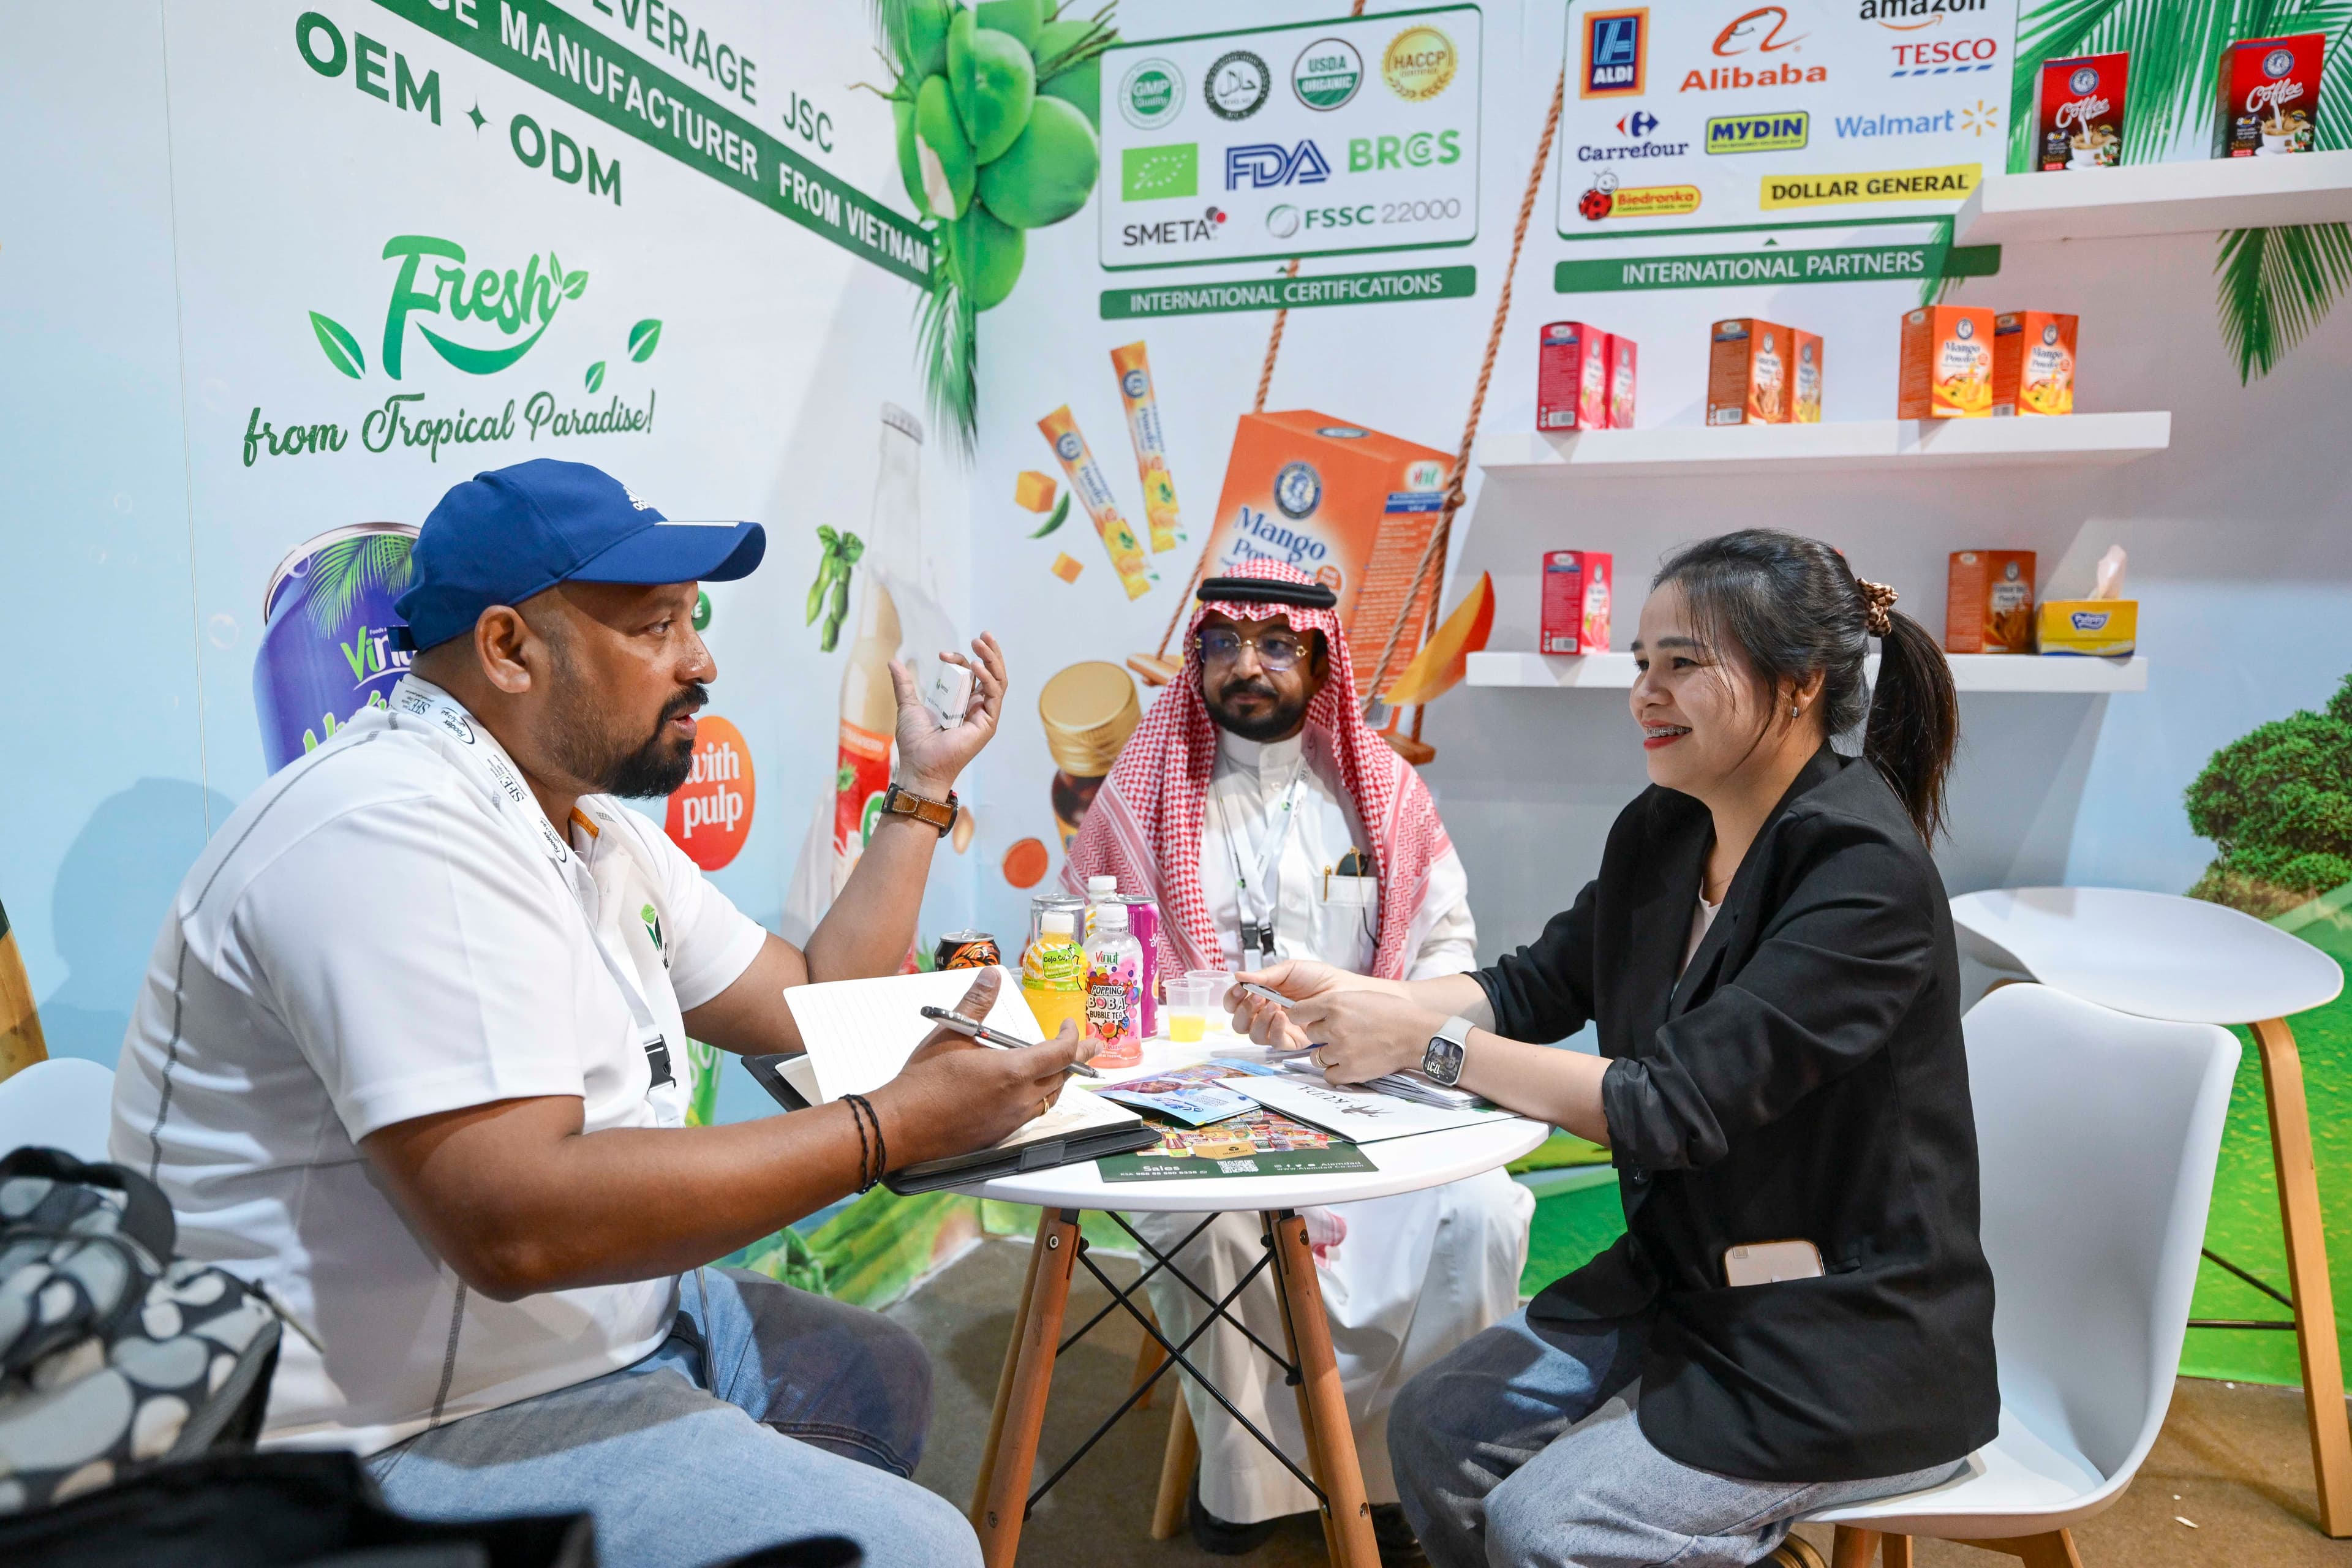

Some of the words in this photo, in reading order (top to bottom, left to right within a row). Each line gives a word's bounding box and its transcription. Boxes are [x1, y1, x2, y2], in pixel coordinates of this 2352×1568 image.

[1309, 56, 1346, 72] USDA
[1393, 51, 1446, 69] HACCP
[1892, 38, 1997, 66] TESCO
[296, 11, 442, 126] OEM
[1593, 66, 1634, 85] ALDI
[1679, 64, 1828, 92] Alibaba
[1134, 80, 1170, 97] GMP
[1302, 76, 1353, 93] ORGANIC
[2245, 78, 2304, 113] Coffee
[783, 91, 834, 153] JSC
[1836, 110, 1954, 139] Walmart
[2056, 94, 2111, 128] Coffee
[500, 0, 759, 181] MANUFACTURER
[779, 162, 840, 227] FROM
[846, 201, 929, 274] VIETNAM
[1712, 118, 1803, 141] MYDIN
[510, 113, 621, 206] ODM
[1226, 140, 1332, 190] FDA
[1578, 141, 1689, 162] Carrefour
[1617, 192, 1694, 206] Biedronka
[1771, 181, 1857, 201] DOLLAR
[1866, 173, 1969, 195] GENERAL
[1305, 205, 1376, 230] FSSC
[1381, 197, 1461, 225] 22000
[1123, 217, 1212, 247] SMETA
[1622, 257, 1800, 284] INTERNATIONAL
[1806, 251, 1924, 276] PARTNERS
[1130, 284, 1280, 312] INTERNATIONAL
[1283, 273, 1442, 300] CERTIFICATIONS
[382, 235, 562, 381] Fresh
[243, 407, 348, 467] from
[362, 393, 515, 463] Tropical
[524, 388, 656, 442] Paradise!
[1234, 507, 1325, 564] Mango
[443, 719, 466, 737] Foodex
[685, 742, 741, 785] with
[500, 777, 524, 802] SFE
[682, 784, 744, 839] pulp
[543, 831, 560, 853] Foodex
[1095, 951, 1119, 966] Vinut
[1088, 995, 1126, 1011] BOBA
[1092, 986, 1122, 996] POPPING
[1090, 1011, 1110, 1019] BUBBLE
[1112, 1011, 1123, 1020] TEA
[1427, 1060, 1441, 1075] 17:31
